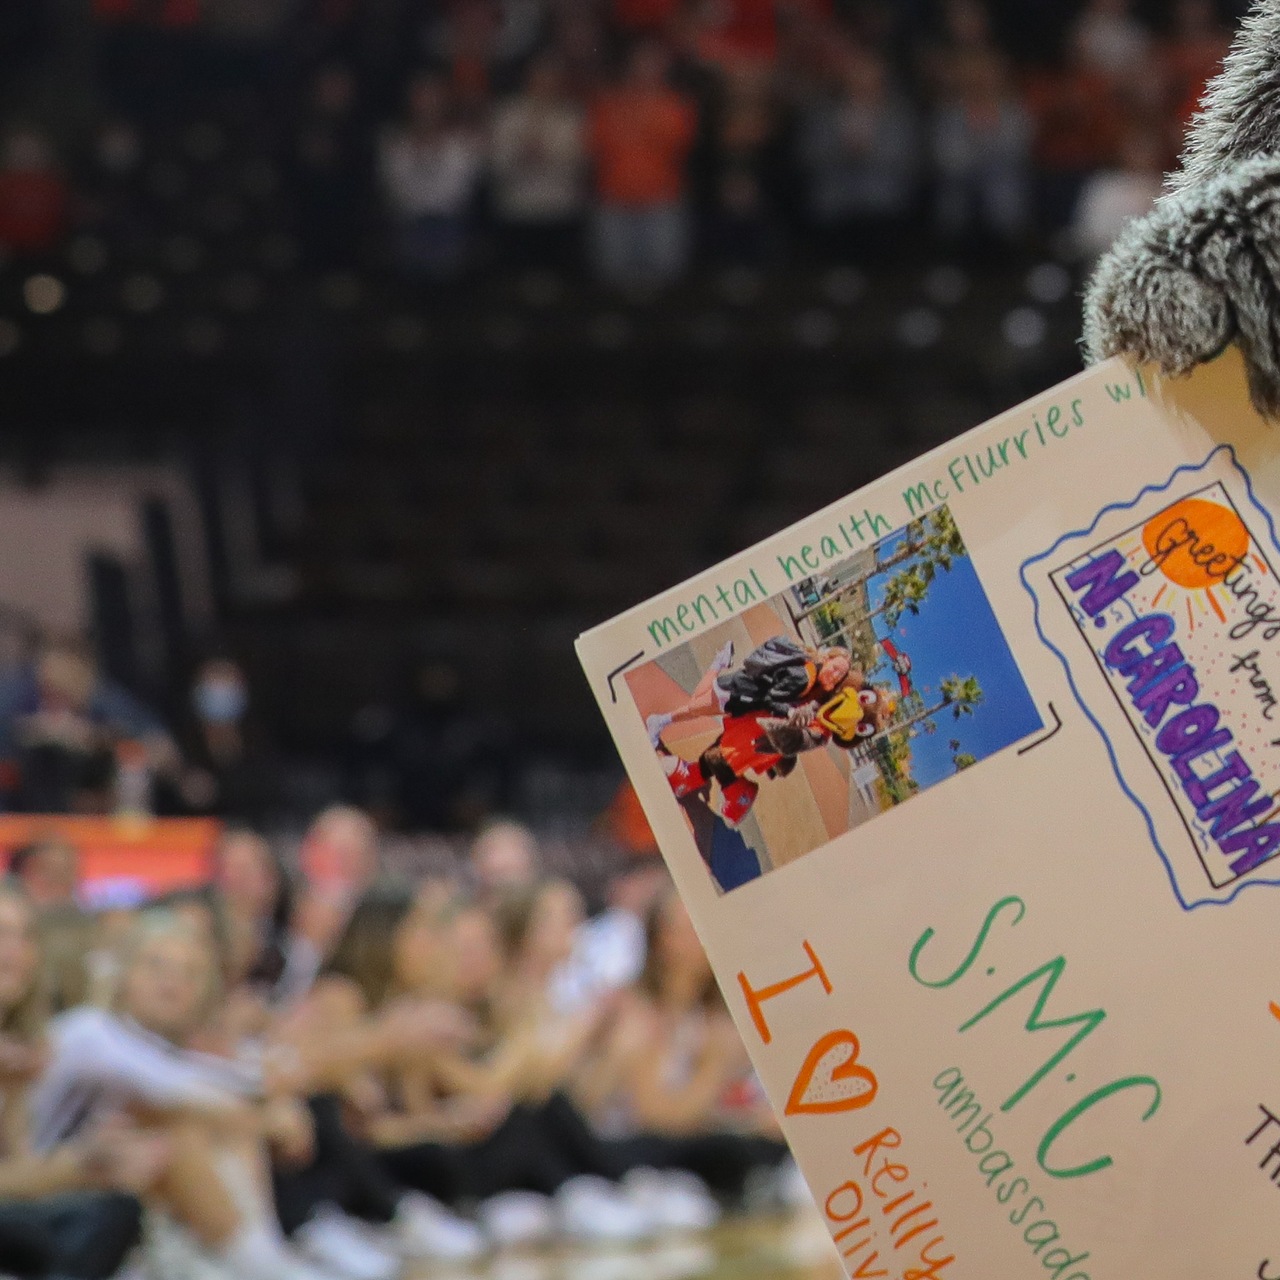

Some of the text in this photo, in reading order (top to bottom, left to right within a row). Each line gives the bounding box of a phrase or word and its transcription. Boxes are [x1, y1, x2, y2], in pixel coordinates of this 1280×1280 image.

[647, 567, 769, 648] mental
[776, 508, 892, 581] health
[1229, 649, 1279, 721] from
[852, 1125, 956, 1280] Reilly
[932, 1066, 1094, 1280] ambassad
